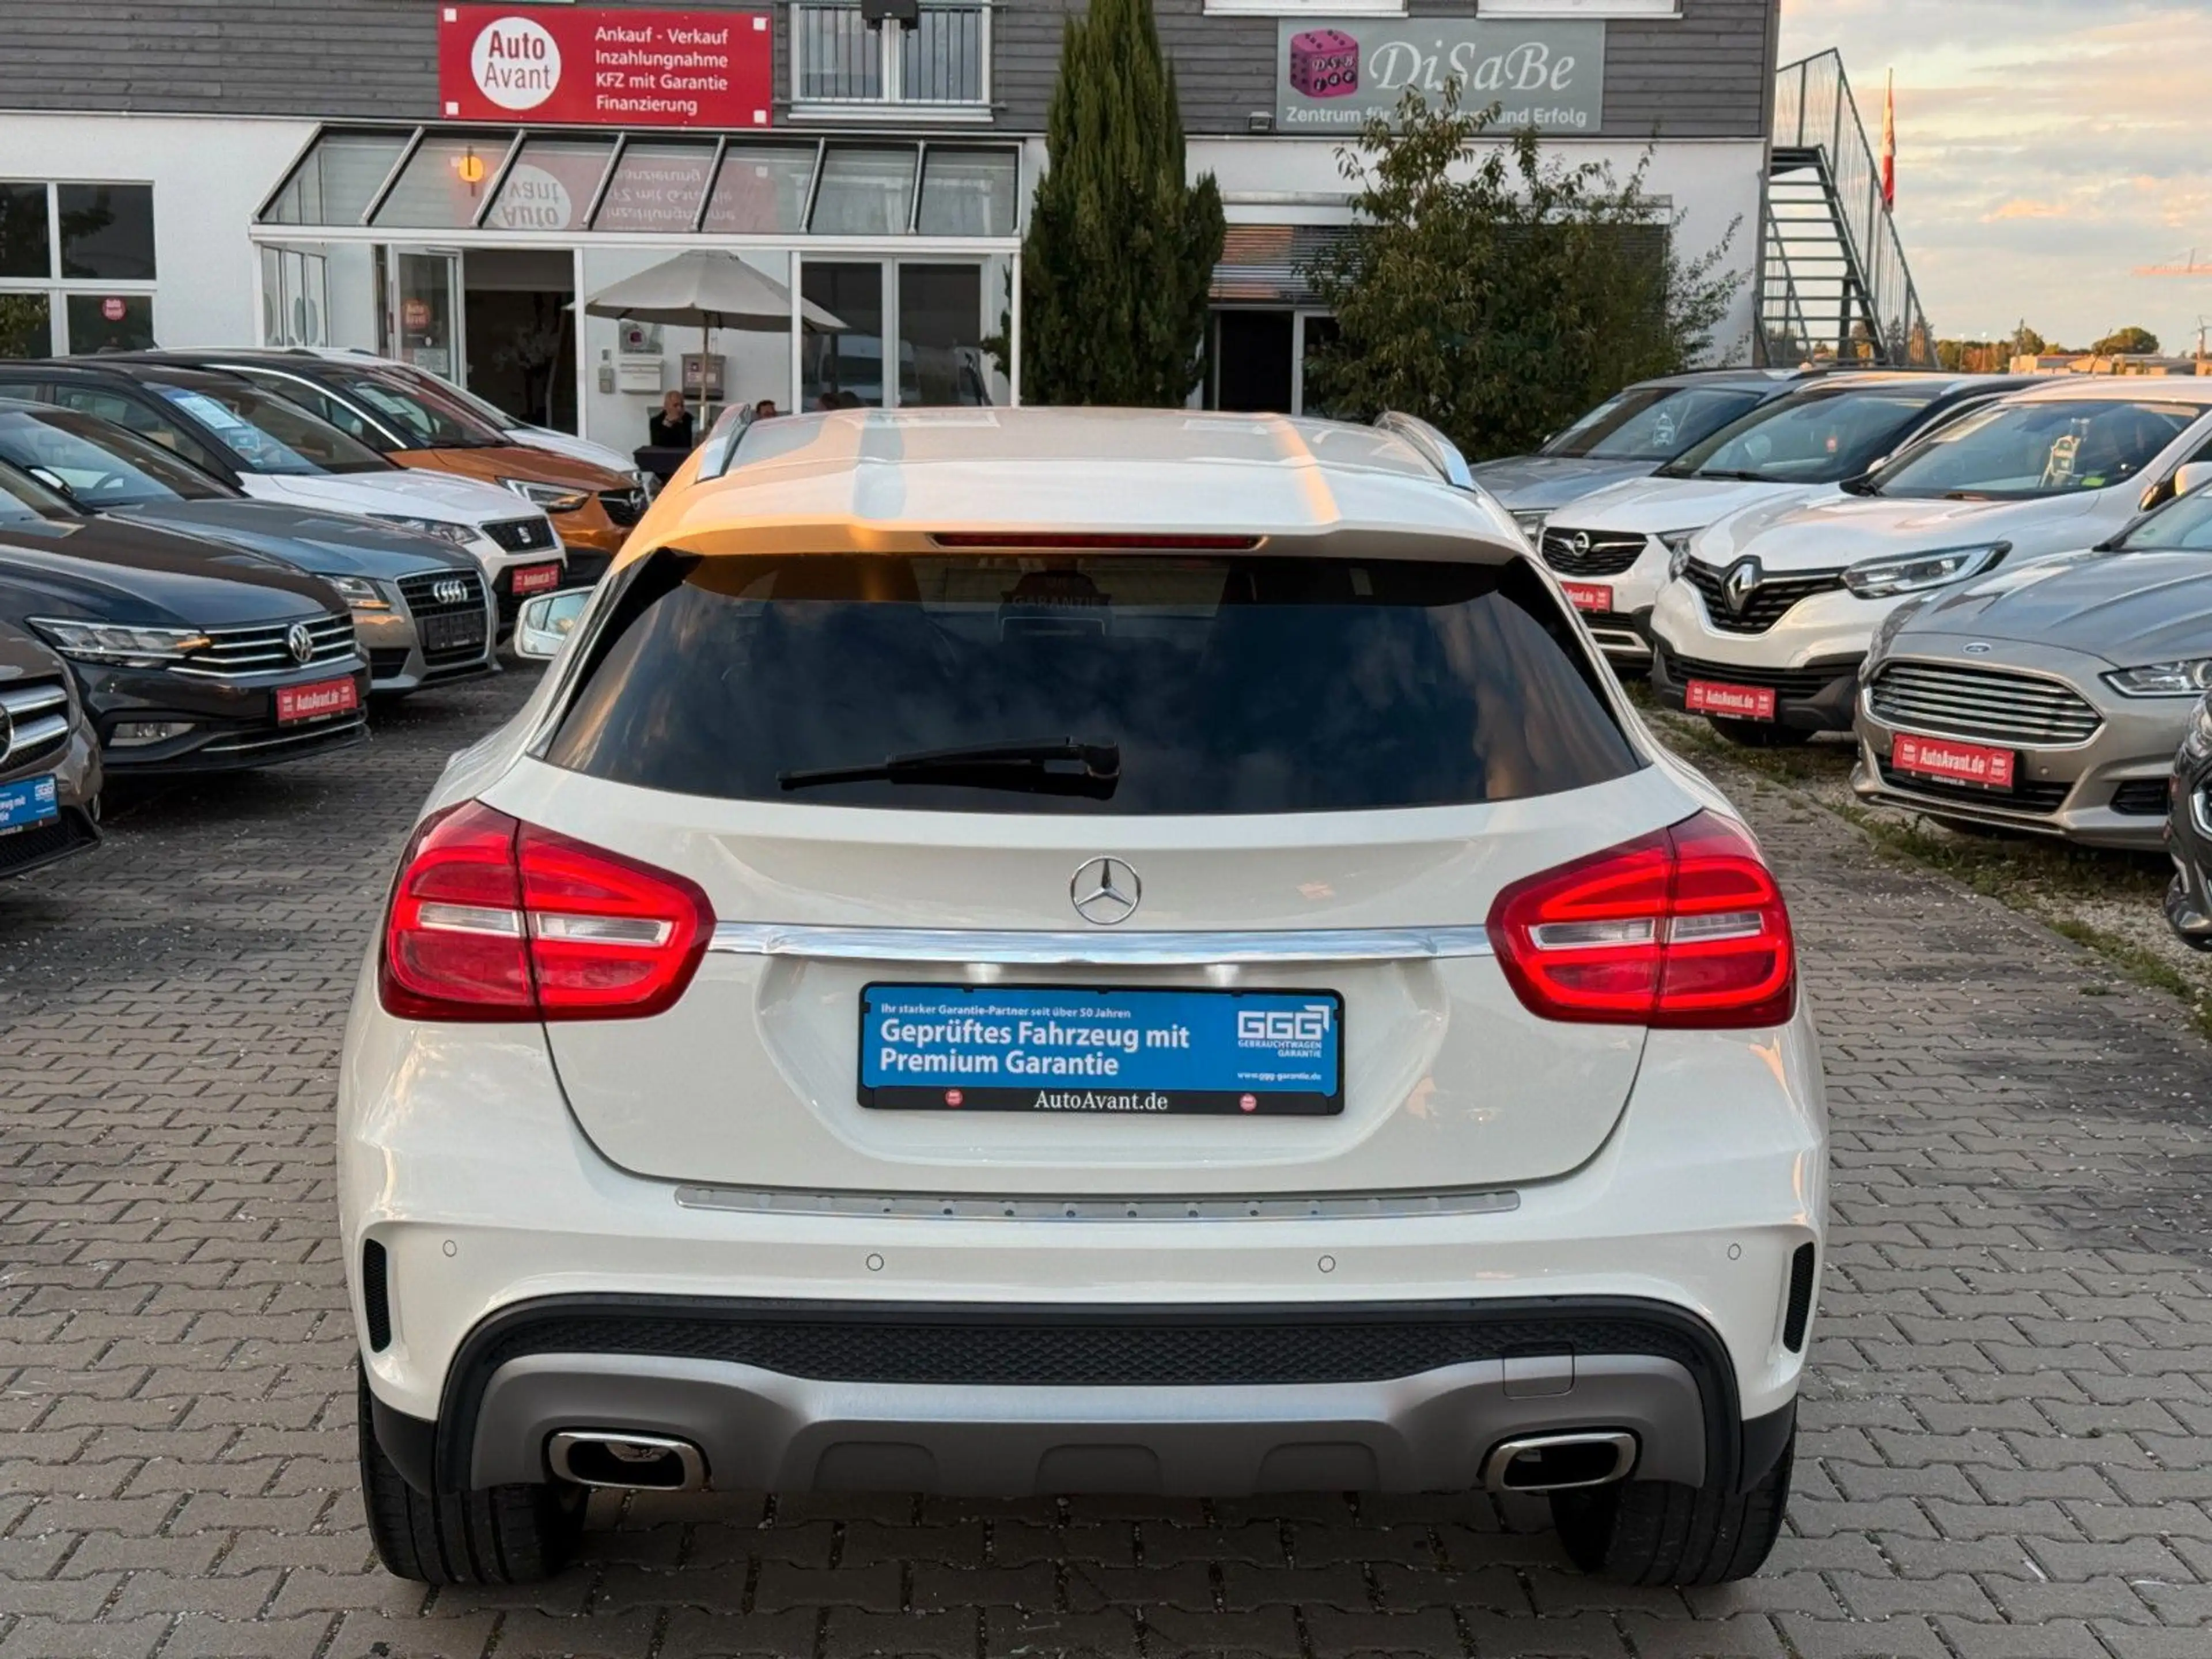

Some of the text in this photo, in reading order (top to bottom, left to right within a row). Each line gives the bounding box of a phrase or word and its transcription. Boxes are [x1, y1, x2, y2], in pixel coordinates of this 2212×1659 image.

[488, 30, 546, 60] Auto
[594, 26, 653, 43] Ankauf
[667, 28, 729, 44] Verkauf
[595, 48, 729, 70] Inzahlungnahme
[1369, 40, 1575, 91] DiSaBe
[484, 62, 551, 90] Avant
[595, 72, 729, 90] KFZ mit Garantie
[596, 94, 698, 116] Finanzierung
[1286, 106, 1361, 123] Zentrum
[1498, 108, 1531, 123] und
[1533, 107, 1587, 128] Erfolg
[1920, 747, 1985, 774] AutoAvant.de
[881, 1003, 1131, 1019] Ihr starker Garantie-Partner seit über 50 Jahren
[880, 1017, 1191, 1053] Geprüftes Fahrzeug mit
[1238, 1010, 1322, 1040] GGG
[1238, 1039, 1322, 1050] GEBRAUCHTWAGEN
[1277, 1050, 1322, 1058] GARANTIE
[880, 1047, 1120, 1076] Premium Garantie
[1033, 1090, 1169, 1111] AutoAvant.de
